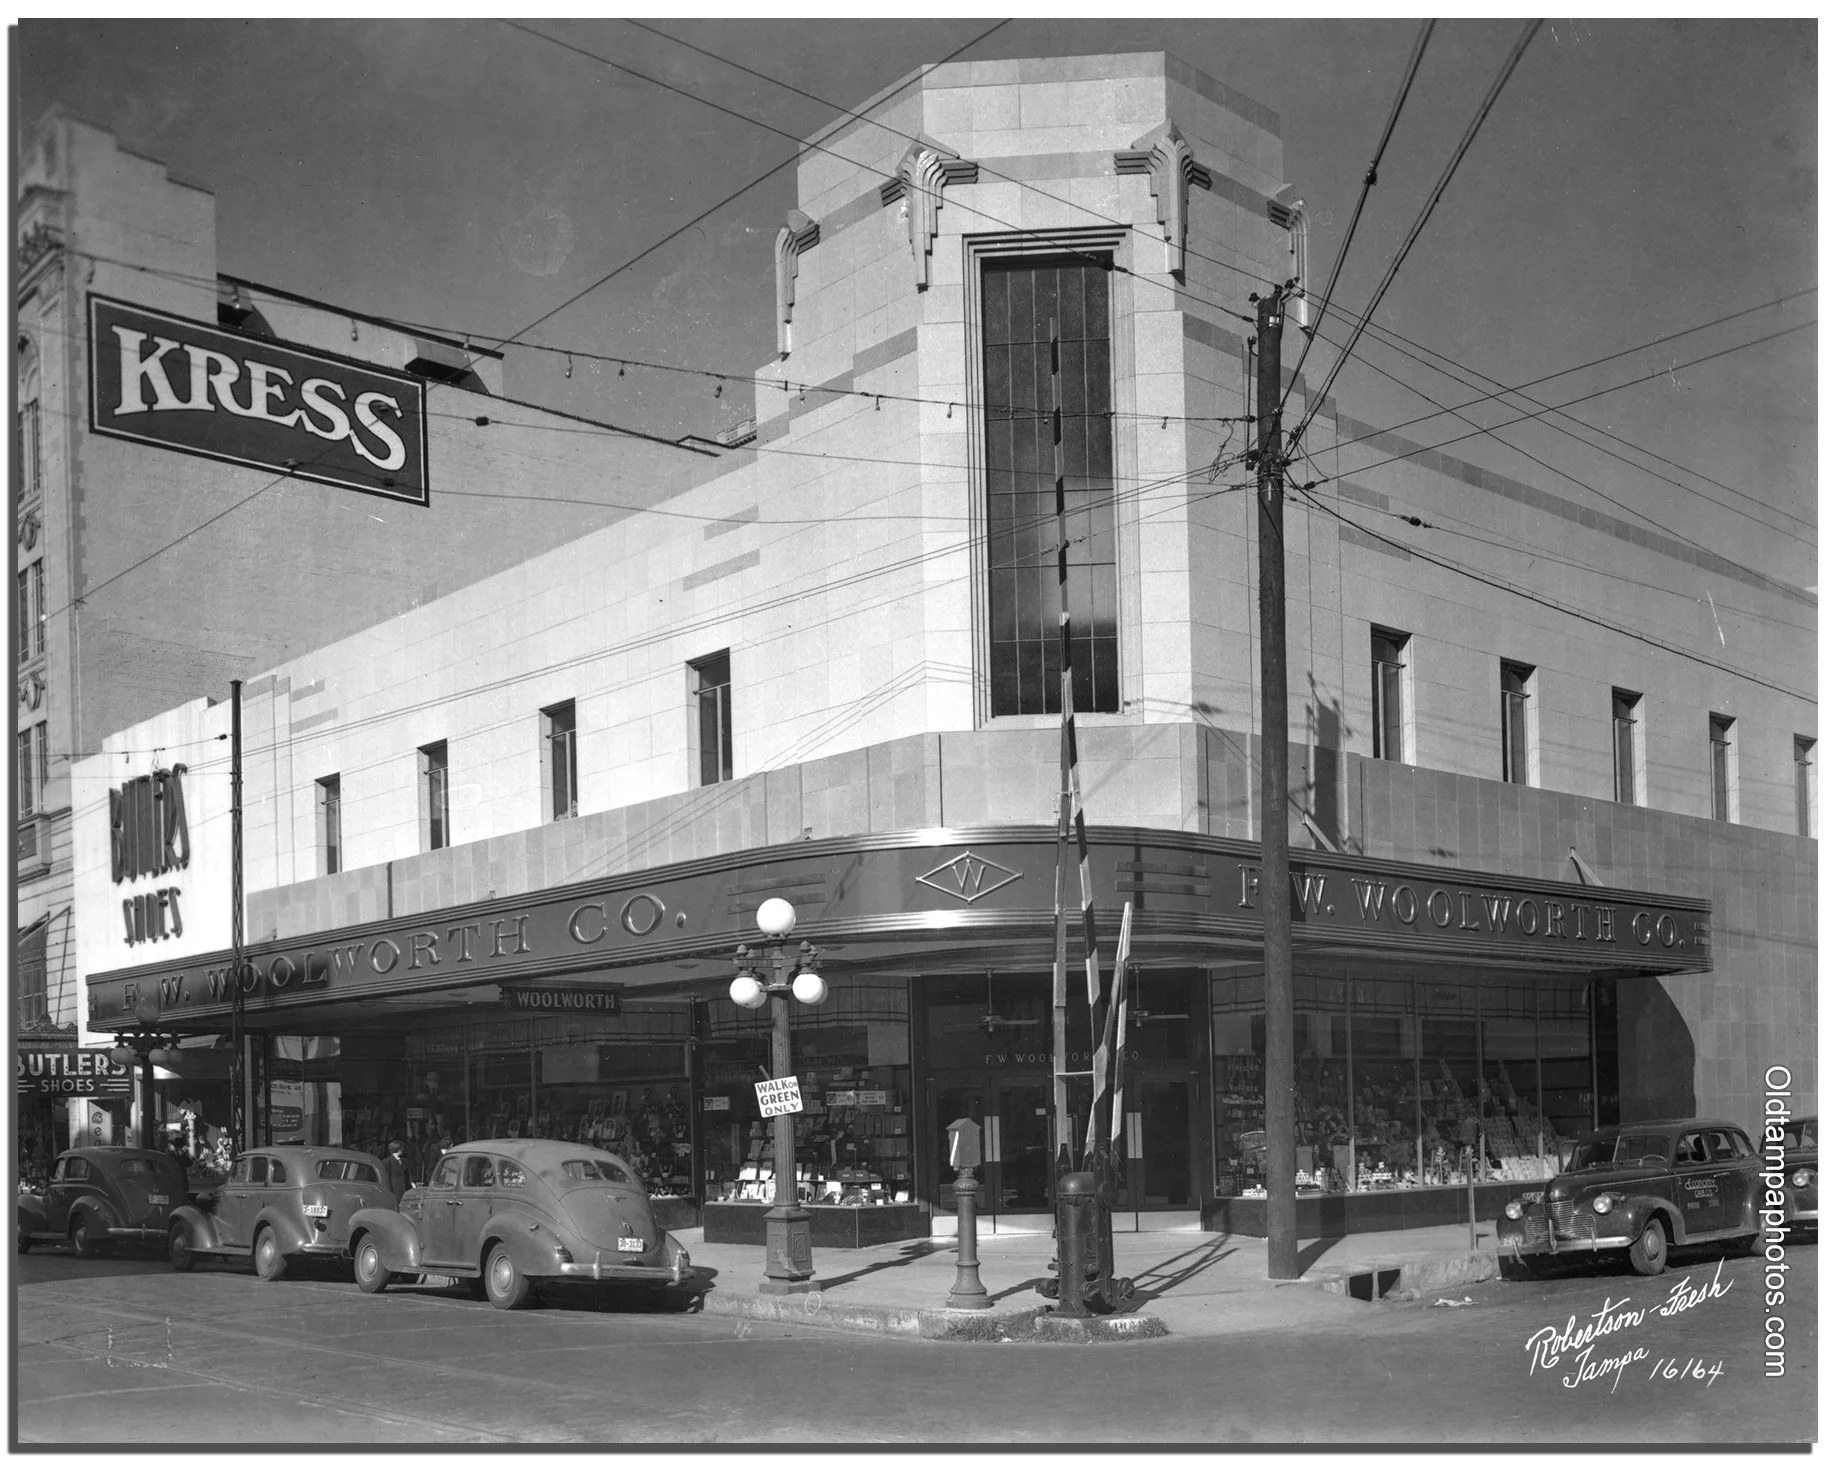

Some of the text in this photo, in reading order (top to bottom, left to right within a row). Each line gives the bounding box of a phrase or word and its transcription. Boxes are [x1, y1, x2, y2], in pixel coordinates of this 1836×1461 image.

[111, 325, 407, 472] KRESS
[952, 859, 987, 893] W
[1289, 871, 1336, 916] W.
[1351, 877, 1616, 943] WOOLWORTH
[1632, 911, 1685, 949] CO.
[157, 974, 190, 1004] W.
[203, 914, 531, 1001] WOOLWORTH
[568, 893, 687, 945] CO.
[516, 989, 616, 1010] WOOLWORTH
[40, 1078, 95, 1093] SHOES
[757, 1079, 798, 1094] WALK ON
[760, 1089, 800, 1106] GREEN
[764, 1101, 799, 1116] ONLY
